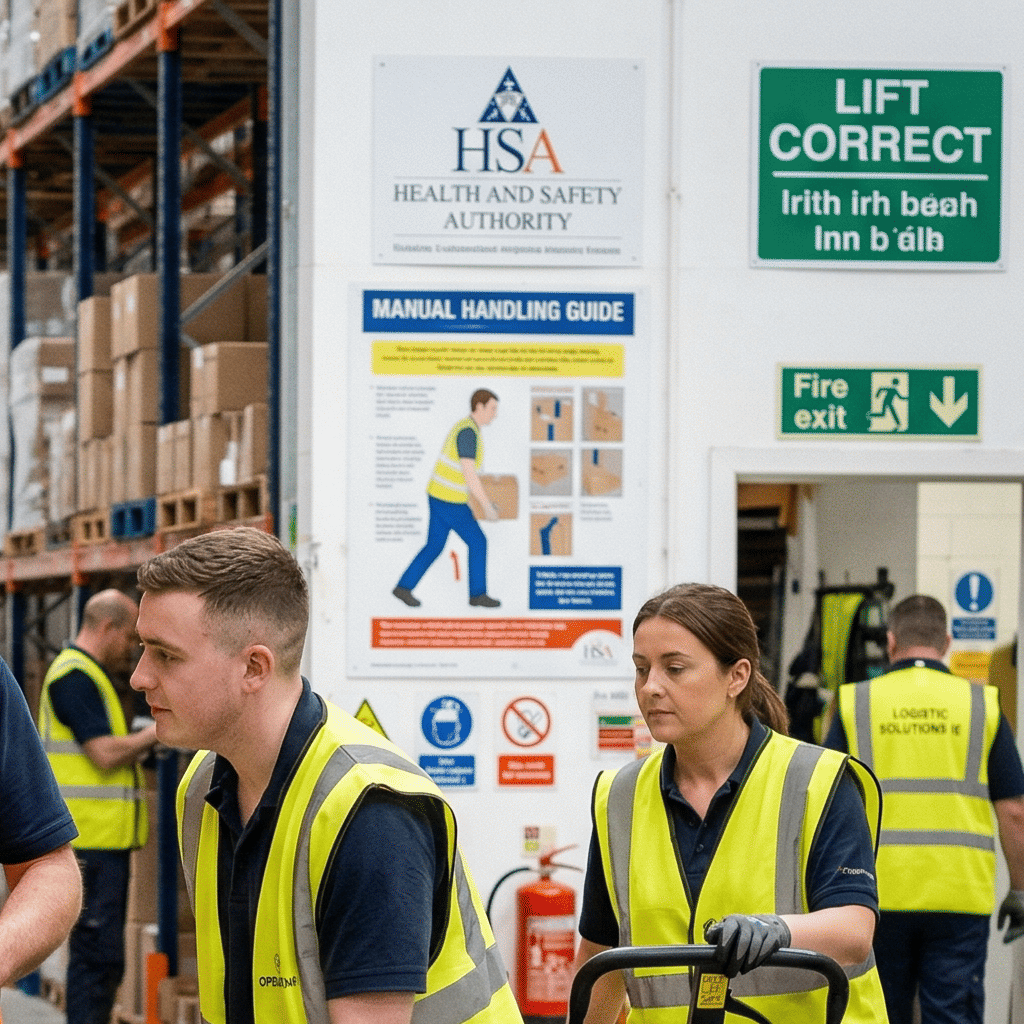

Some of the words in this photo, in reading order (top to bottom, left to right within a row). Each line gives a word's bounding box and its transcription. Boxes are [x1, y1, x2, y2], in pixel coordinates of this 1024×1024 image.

[835, 78, 929, 115] LIFT
[452, 127, 564, 173] HSA
[769, 123, 992, 163] CORRECT
[393, 183, 480, 202] HEALTH
[486, 185, 535, 203] AND
[539, 186, 622, 204] SAFETY
[851, 189, 891, 216] irh
[443, 211, 573, 230] AUTHORITY
[372, 298, 456, 319] MANUAL
[461, 299, 561, 321] HANDLING
[566, 300, 625, 322] GUIDE
[794, 372, 849, 399] Fire
[794, 403, 847, 430] exit
[892, 708, 948, 719] LOGISTIC
[879, 722, 947, 735] SOLUTIONS
